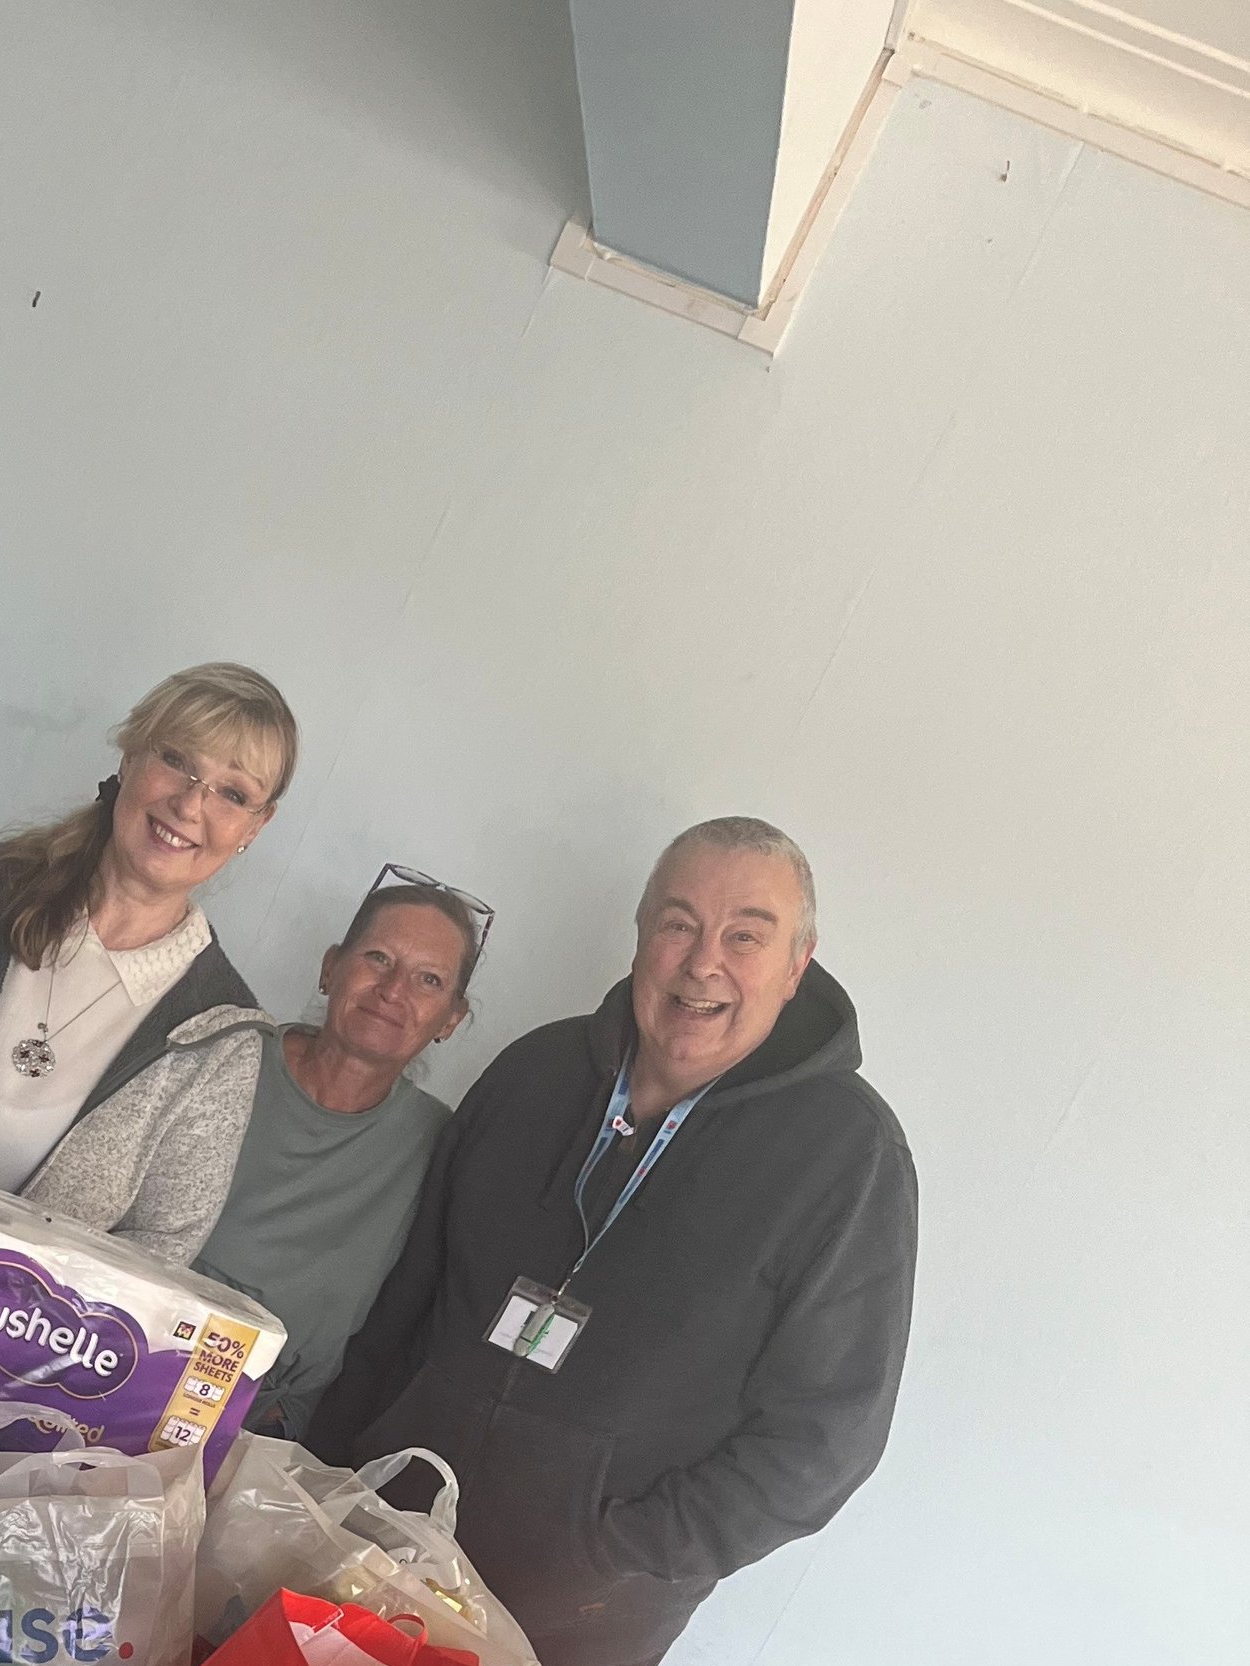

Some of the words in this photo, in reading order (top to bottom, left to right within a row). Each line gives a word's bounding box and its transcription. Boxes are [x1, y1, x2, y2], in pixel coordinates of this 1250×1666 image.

[204, 1332, 246, 1359] 50%
[193, 1361, 234, 1383] SHEETS
[199, 1349, 240, 1373] MORE
[199, 1383, 211, 1397] 8
[174, 1424, 191, 1443] 12
